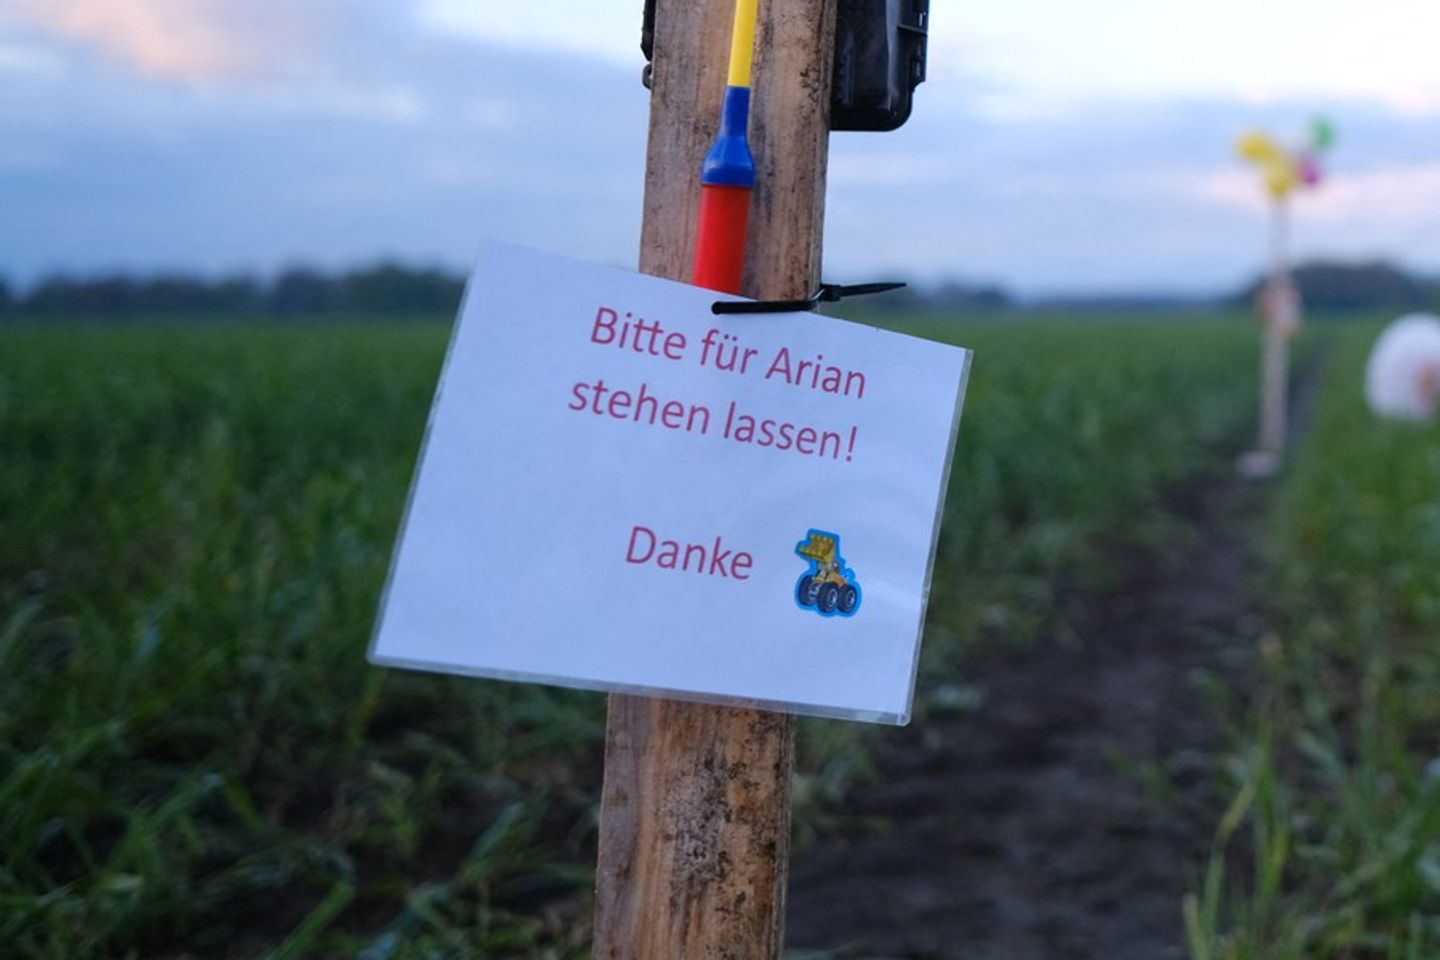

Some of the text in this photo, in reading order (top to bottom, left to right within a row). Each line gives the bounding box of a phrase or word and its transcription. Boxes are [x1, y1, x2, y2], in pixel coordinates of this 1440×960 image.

[590, 306, 866, 398] Bitte für Arian
[567, 379, 858, 463] stehen lassen!
[625, 526, 754, 580] Danke
